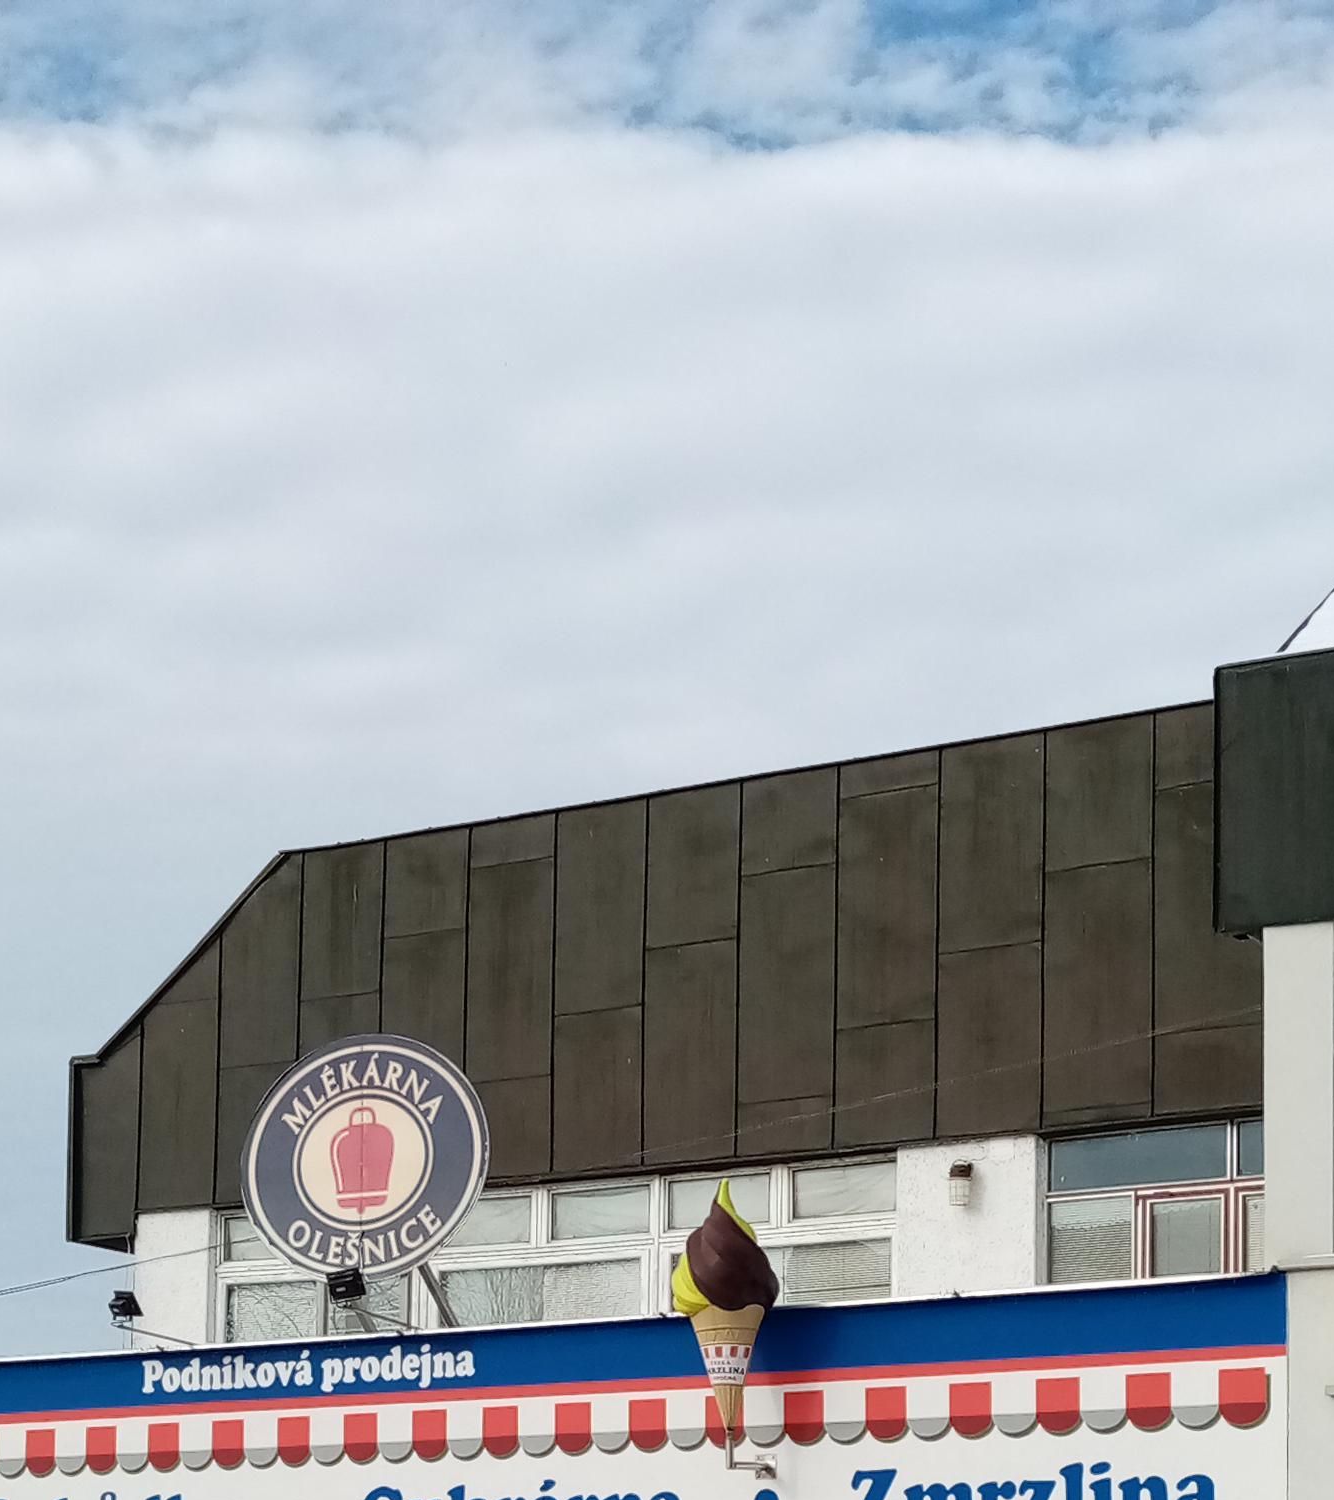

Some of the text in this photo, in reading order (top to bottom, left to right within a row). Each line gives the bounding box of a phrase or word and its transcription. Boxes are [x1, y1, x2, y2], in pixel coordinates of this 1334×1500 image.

[281, 1052, 443, 1135] MLÉKÁRNA
[288, 1204, 442, 1266] OLEŠNICE
[142, 1343, 476, 1394] Podniková prodejna
